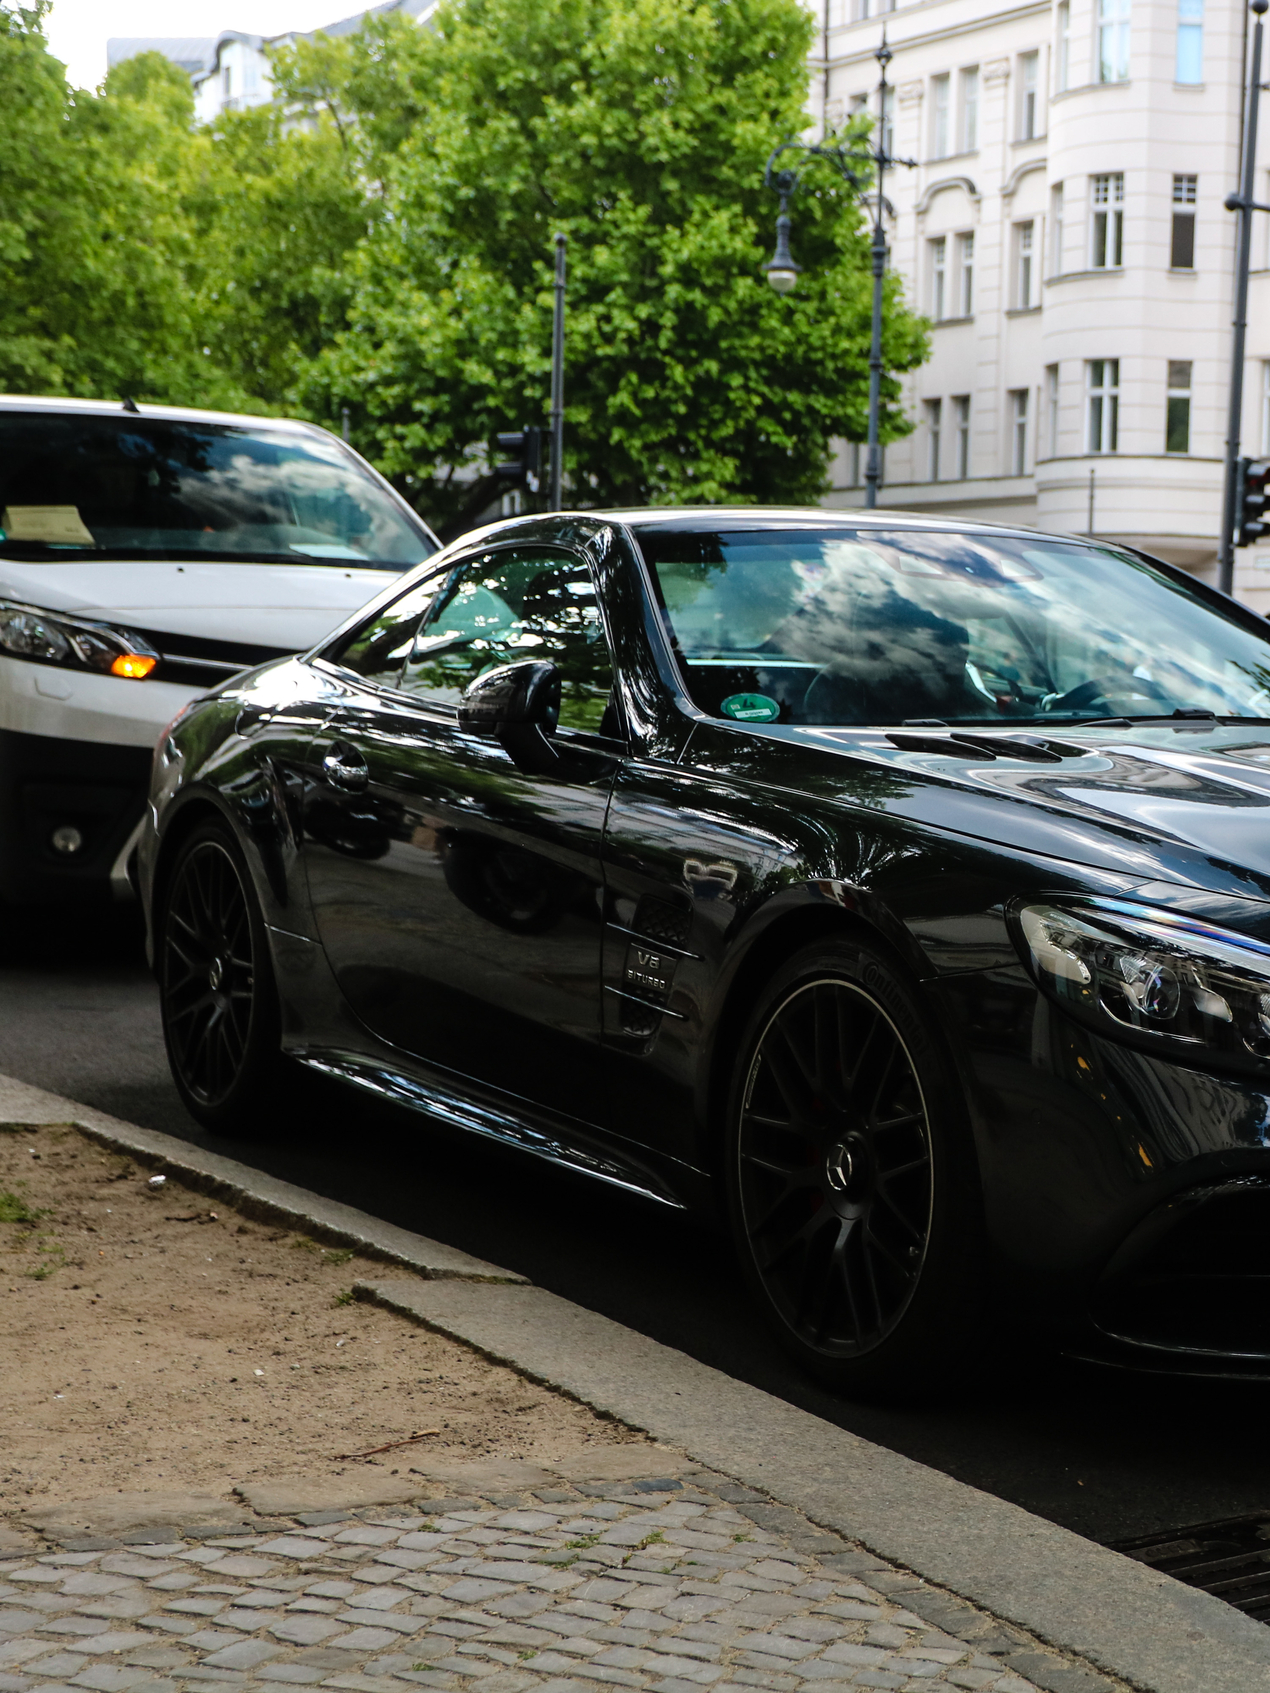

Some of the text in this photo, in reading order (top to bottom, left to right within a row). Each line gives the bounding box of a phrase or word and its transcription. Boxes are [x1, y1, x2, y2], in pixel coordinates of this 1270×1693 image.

[742, 698, 756, 709] 4
[637, 950, 660, 969] V8
[627, 968, 667, 989] BITURBO
[862, 961, 931, 1057] Continental
